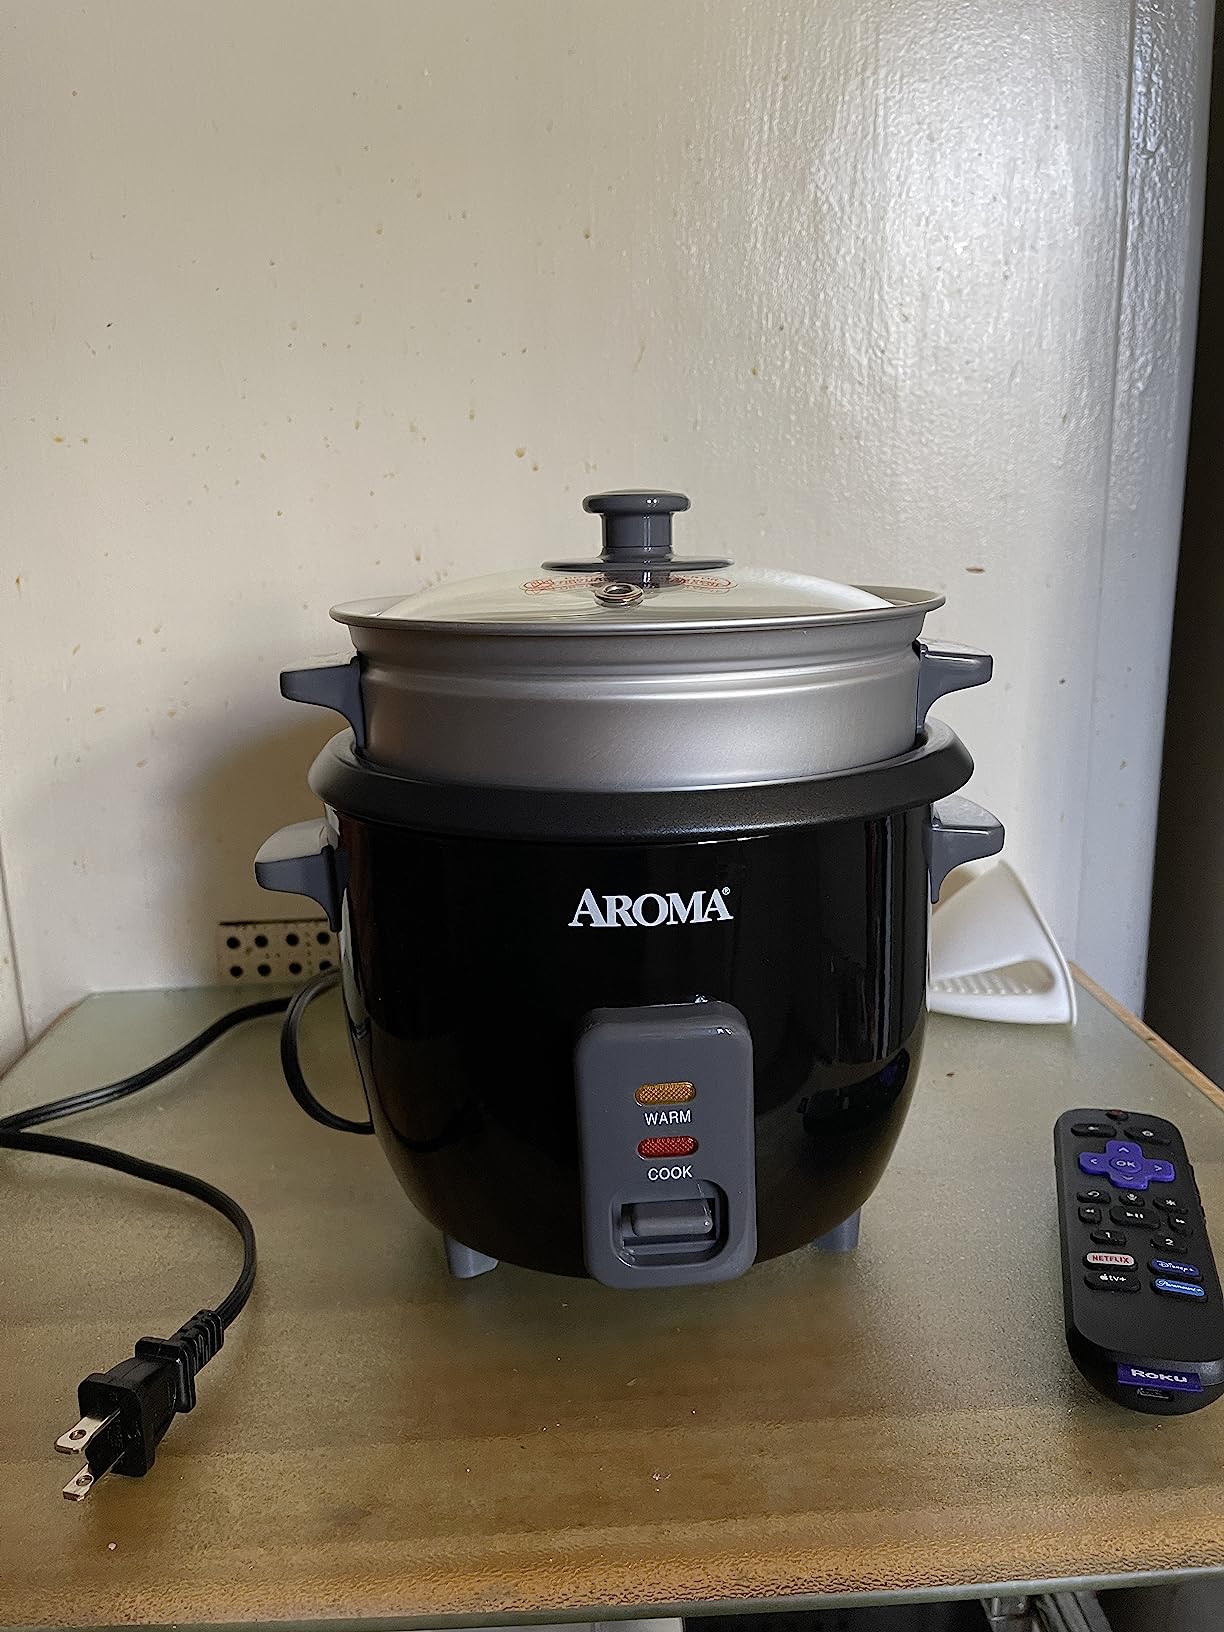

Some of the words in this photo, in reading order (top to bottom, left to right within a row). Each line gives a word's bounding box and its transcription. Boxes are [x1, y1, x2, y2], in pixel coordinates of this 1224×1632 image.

[644, 1109, 692, 1126] WARM
[1116, 1160, 1136, 1168] OK
[647, 1165, 693, 1181] COOK
[1165, 1238, 1174, 1246] 2
[1092, 1254, 1130, 1264] NETFLIX
